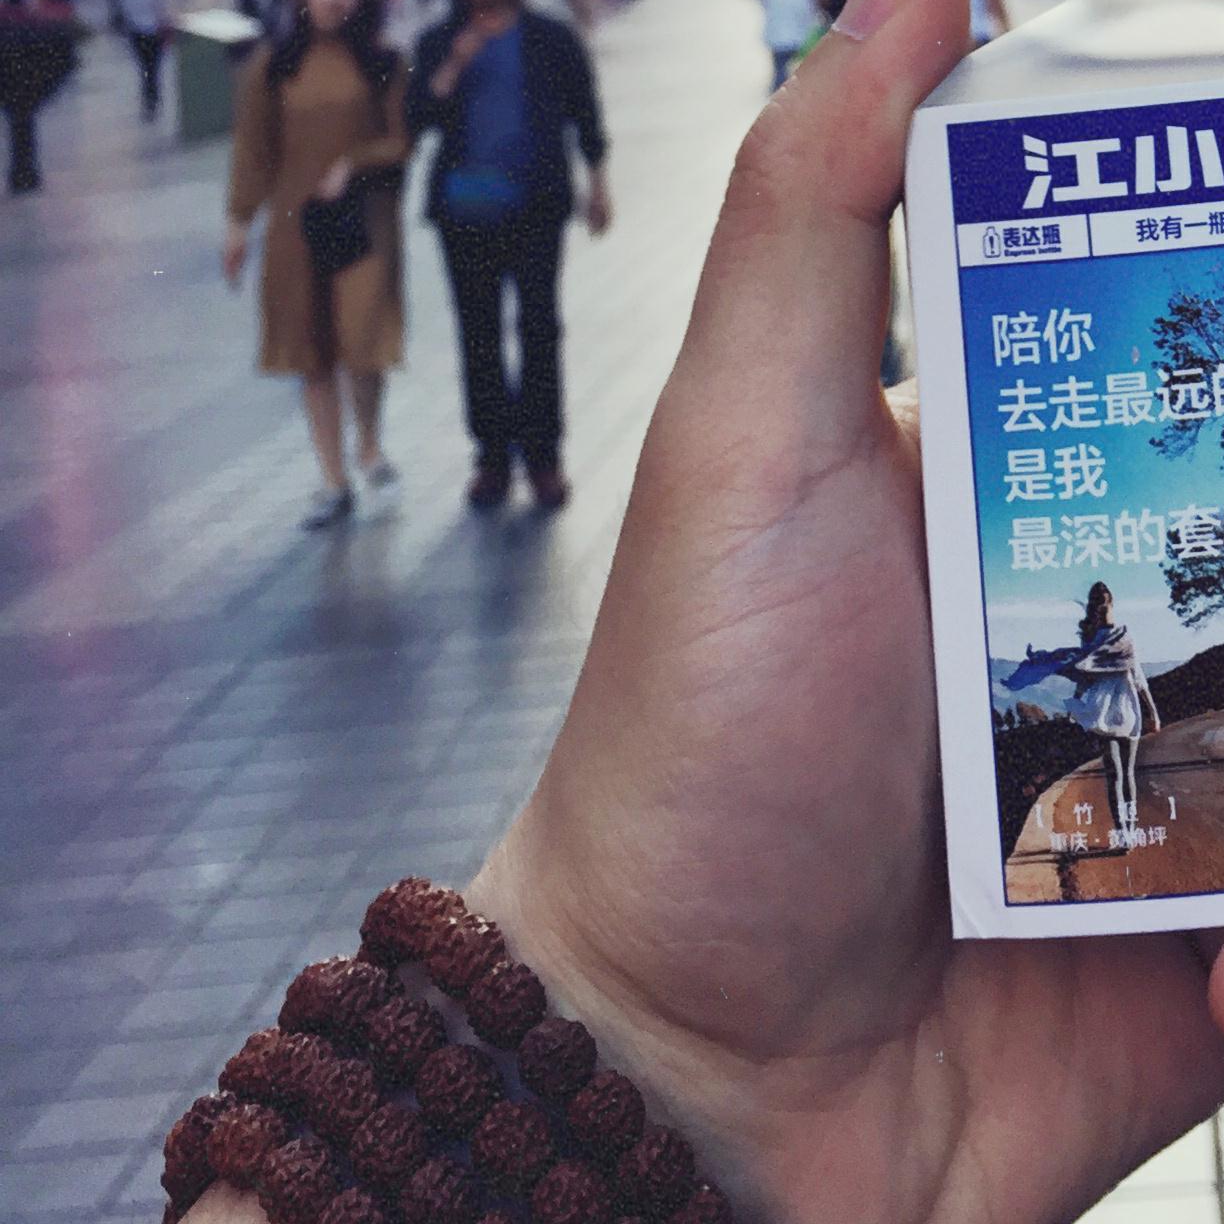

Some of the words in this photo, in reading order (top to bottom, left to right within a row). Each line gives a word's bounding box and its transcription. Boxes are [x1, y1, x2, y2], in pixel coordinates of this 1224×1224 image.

[1002, 224, 1062, 248] 表达瓶
[991, 307, 1096, 367] 陪你
[1003, 442, 1109, 504] 是我
